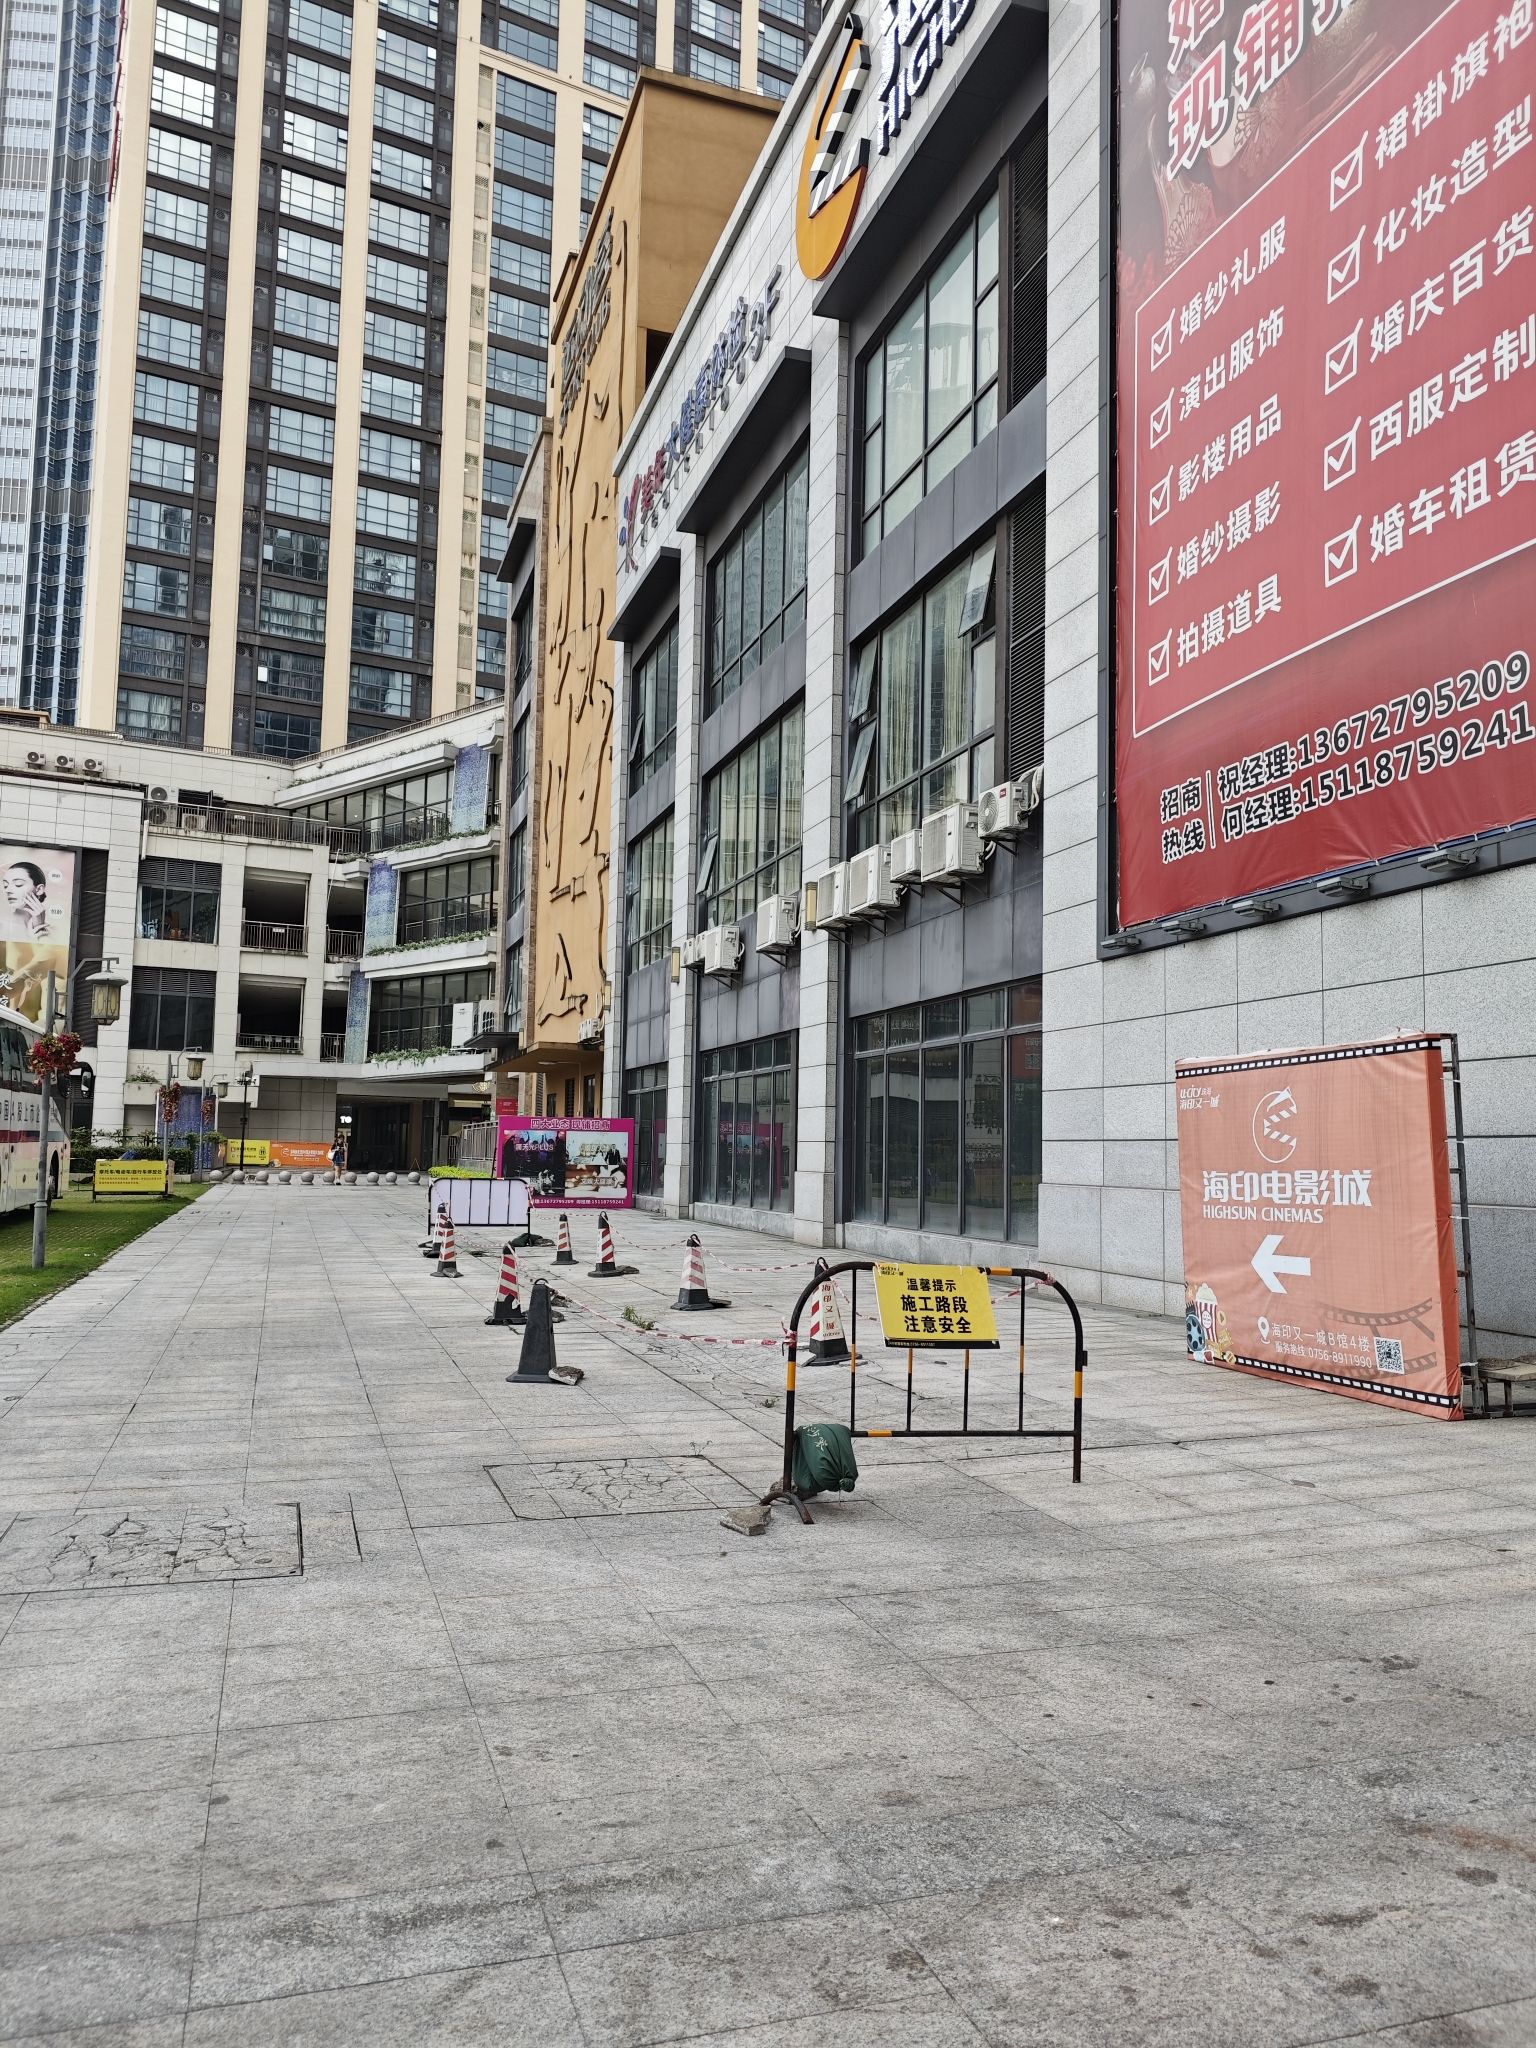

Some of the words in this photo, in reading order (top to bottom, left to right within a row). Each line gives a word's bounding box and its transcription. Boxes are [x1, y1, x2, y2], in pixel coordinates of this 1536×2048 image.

[1374, 0, 1534, 170] 裙褂旗袍
[1373, 93, 1534, 265] 化妆造型
[1178, 215, 1286, 344] 婚纱礼服
[1369, 204, 1534, 363] 婚庆百货
[1178, 304, 1285, 422] 演出服饰
[1369, 313, 1536, 462] 西服定制
[1177, 393, 1283, 502] 影楼用品
[1369, 430, 1536, 563] 婚车租赁
[1176, 481, 1281, 584] 婚纱摄影
[1176, 573, 1282, 668] 拍摄道具
[1217, 650, 1530, 802] 祝经理:13672795209
[1221, 701, 1536, 842] 何经理:15118759241
[1160, 776, 1202, 823] 招商
[1162, 820, 1206, 864] 热线
[1202, 1169, 1373, 1207] 海印电影城
[1202, 1205, 1257, 1221] HIGHSUN
[1261, 1206, 1324, 1224] CINEMAS
[900, 1294, 969, 1314] 施工路段
[904, 1315, 972, 1334] 注意安全
[906, 1278, 957, 1292] 温馨提示
[1271, 1322, 1370, 1353] 海印又一城B馆4楼
